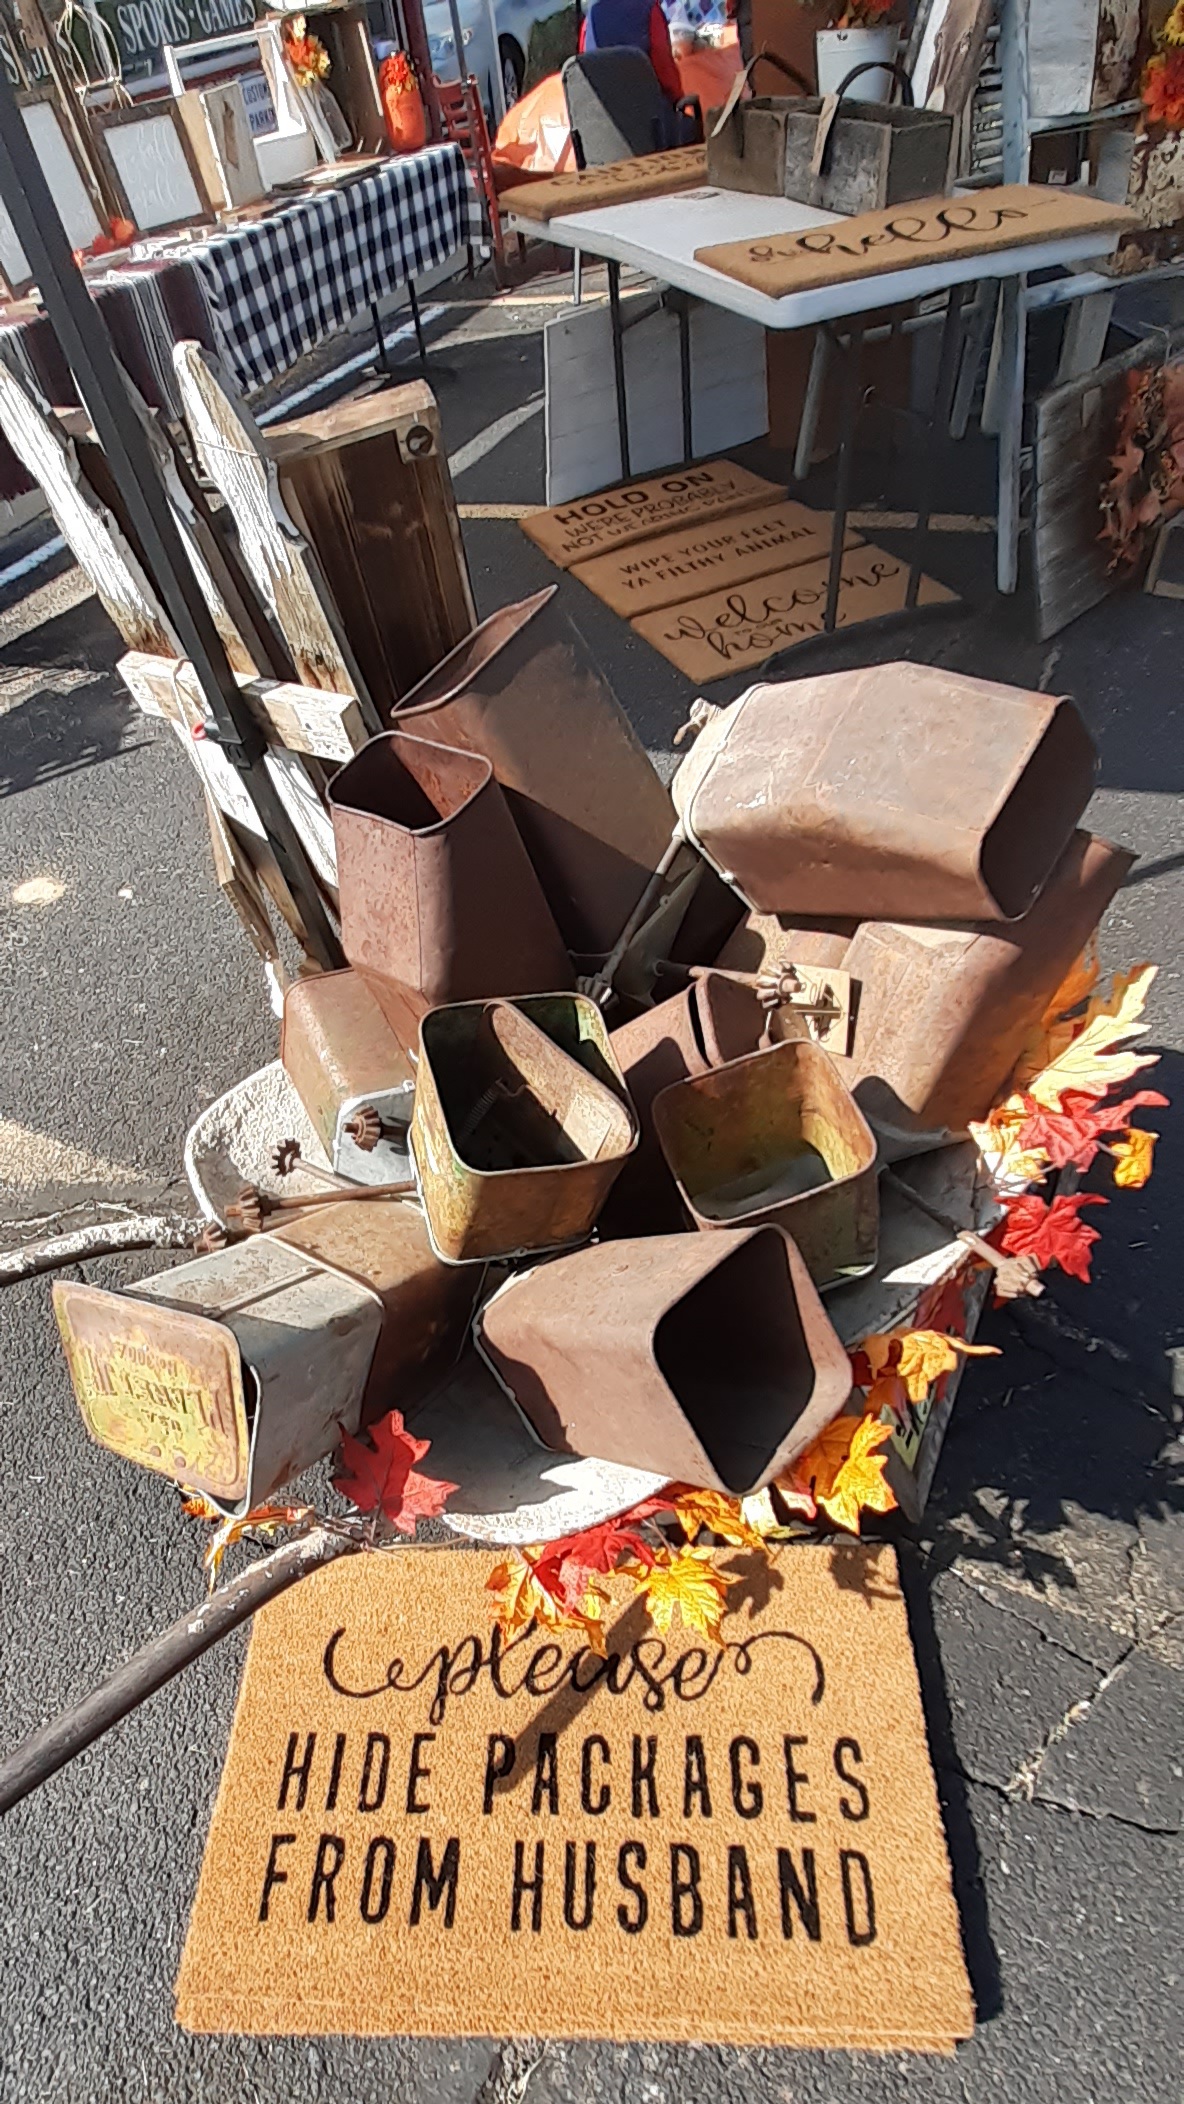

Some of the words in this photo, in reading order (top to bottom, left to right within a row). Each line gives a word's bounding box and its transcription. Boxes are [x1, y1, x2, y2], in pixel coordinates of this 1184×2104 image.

[117, 0, 190, 54] SPORTS
[553, 490, 649, 525] HOLD
[661, 472, 714, 492] ON
[565, 512, 631, 537] WE'RE
[631, 480, 736, 518] PROBABLY
[562, 533, 603, 552] NOT
[620, 553, 675, 575] WIPE
[678, 535, 733, 557] YOUR
[740, 519, 787, 539] FEET
[621, 577, 650, 590] YA
[656, 553, 725, 580] FILTHY
[734, 527, 816, 557] ANIMAL
[664, 563, 899, 641] welcome
[323, 1617, 825, 1726] please
[277, 1732, 436, 1814] HIDE
[483, 1732, 871, 1822] PACKAGES
[258, 1833, 461, 1929] FROM
[510, 1840, 878, 1947] HUSBAND
